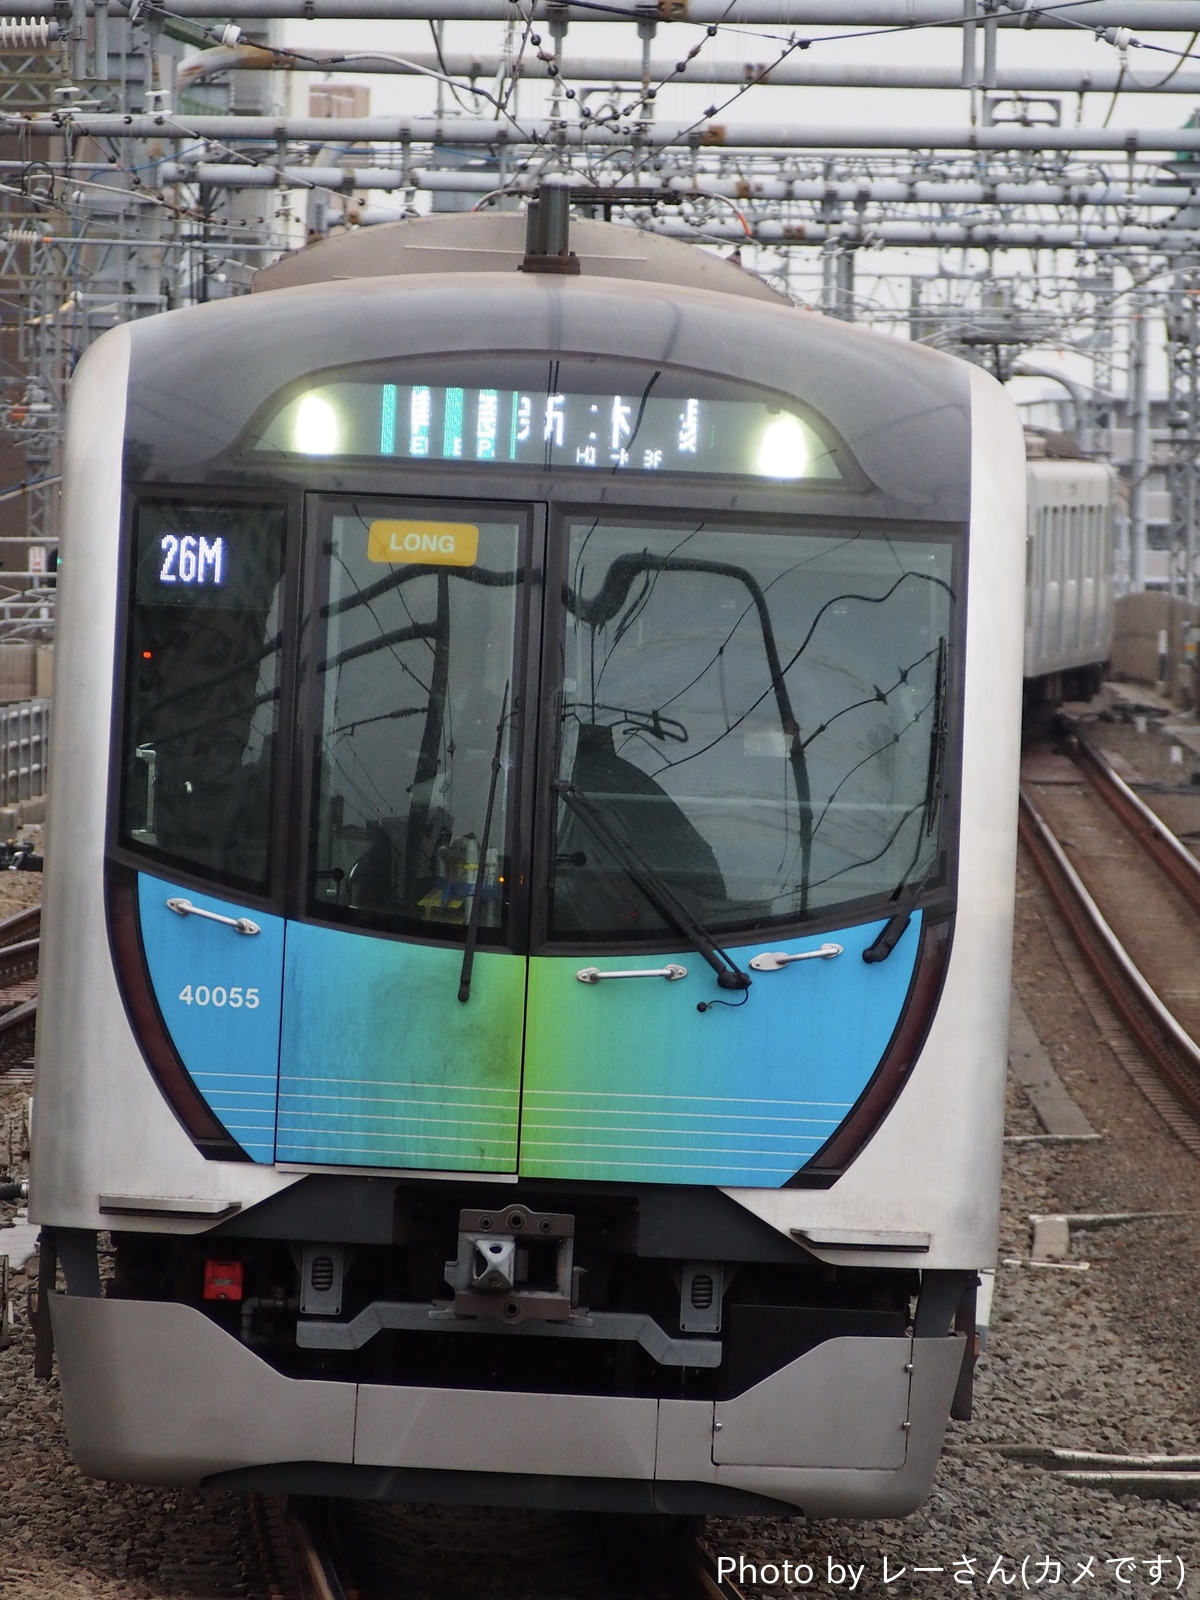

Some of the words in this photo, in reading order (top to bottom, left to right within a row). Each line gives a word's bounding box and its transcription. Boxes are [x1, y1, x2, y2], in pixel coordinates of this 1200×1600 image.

[389, 532, 455, 554] LONG
[159, 534, 224, 585] 26M
[178, 984, 260, 1009] 40055
